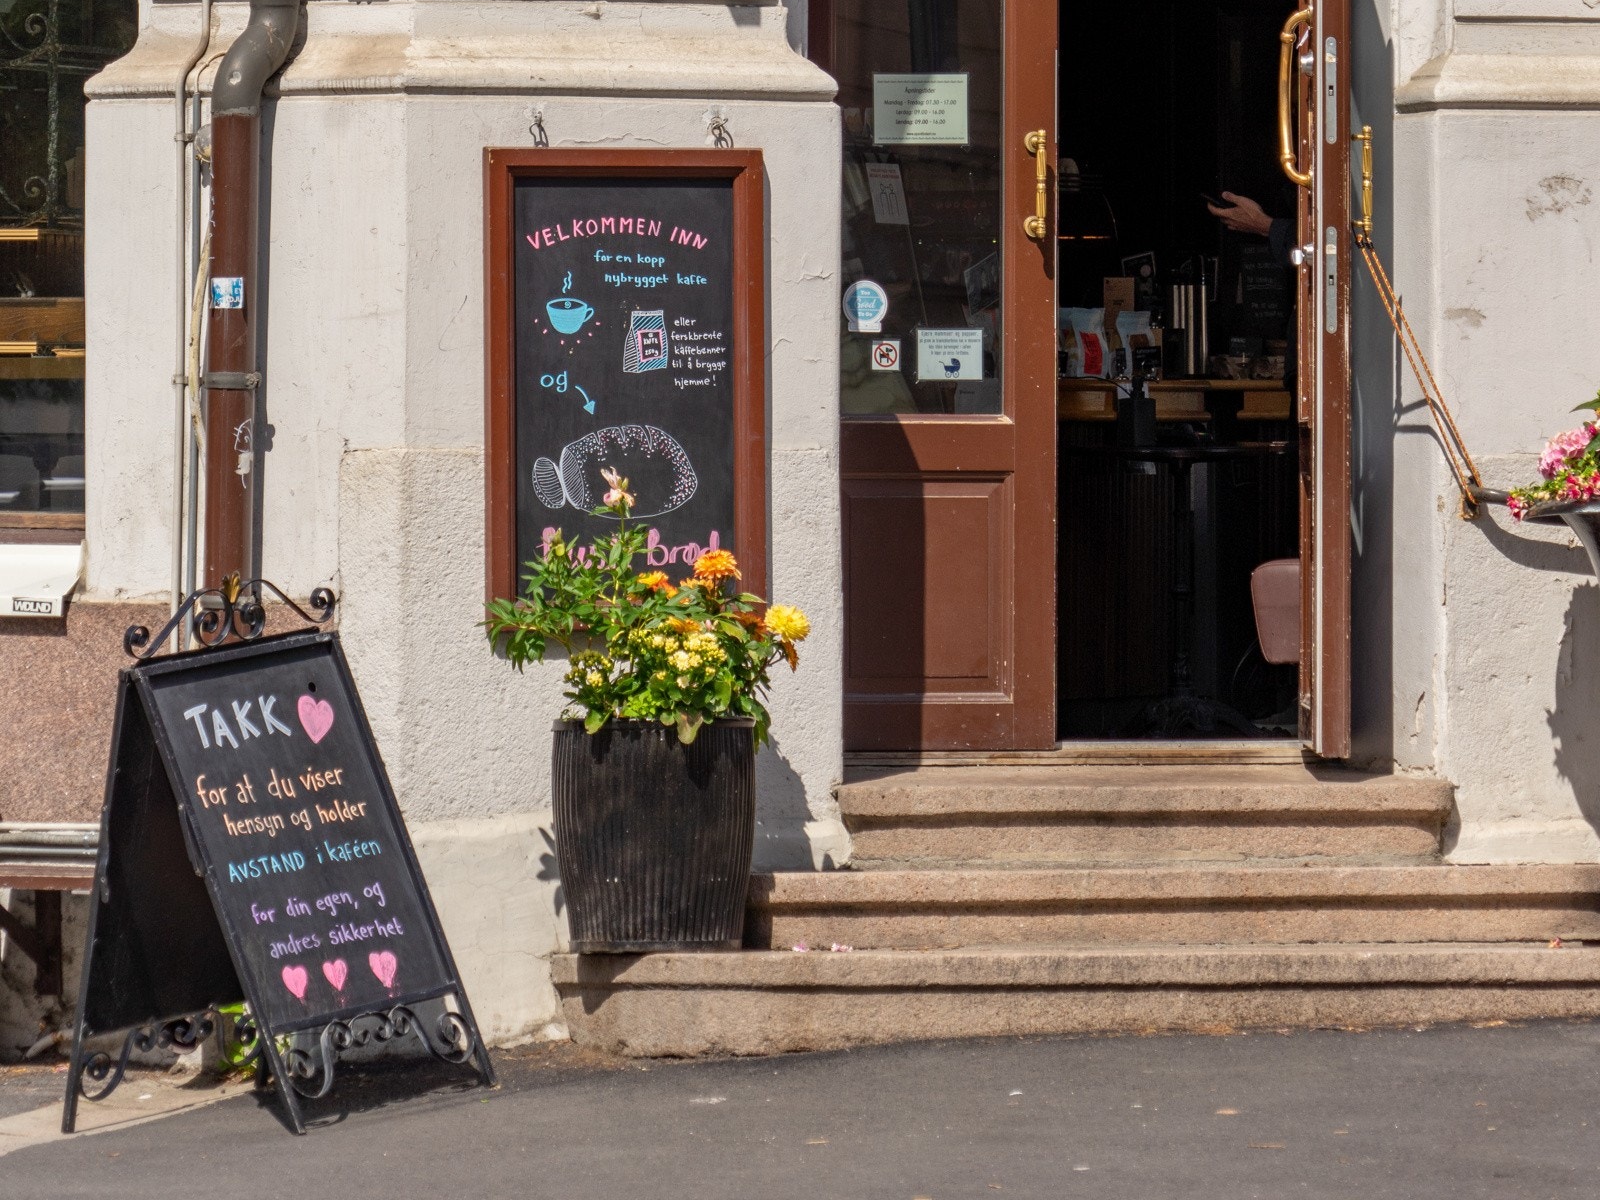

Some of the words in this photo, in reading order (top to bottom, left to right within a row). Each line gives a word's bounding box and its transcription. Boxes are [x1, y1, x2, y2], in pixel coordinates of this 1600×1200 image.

[526, 216, 662, 250] VELKOMMEN
[669, 226, 708, 250] INN
[593, 250, 613, 263] for
[615, 253, 632, 263] en
[637, 253, 665, 268] kopp
[604, 272, 669, 288] nybrygget
[676, 272, 708, 286] kaffe
[671, 330, 723, 341] ferskbrente
[674, 316, 697, 327] eller
[540, 370, 568, 392] og
[671, 359, 682, 369] til
[687, 357, 693, 370] å
[695, 359, 727, 372] brygge
[183, 694, 292, 750] TAKK
[196, 773, 228, 809] for
[235, 773, 257, 804] at
[267, 767, 297, 800] du
[299, 766, 344, 792] viser
[223, 812, 285, 839] hensyn
[290, 807, 312, 831] og
[315, 800, 368, 825] holder
[228, 850, 306, 884] AVSTAND
[314, 847, 324, 864] i
[324, 838, 382, 863] kaféen
[250, 902, 275, 925] for
[285, 896, 312, 917] din
[315, 891, 358, 917] egen,
[363, 881, 386, 907] og
[269, 932, 322, 959] andres
[328, 917, 404, 946] sikkerhet
